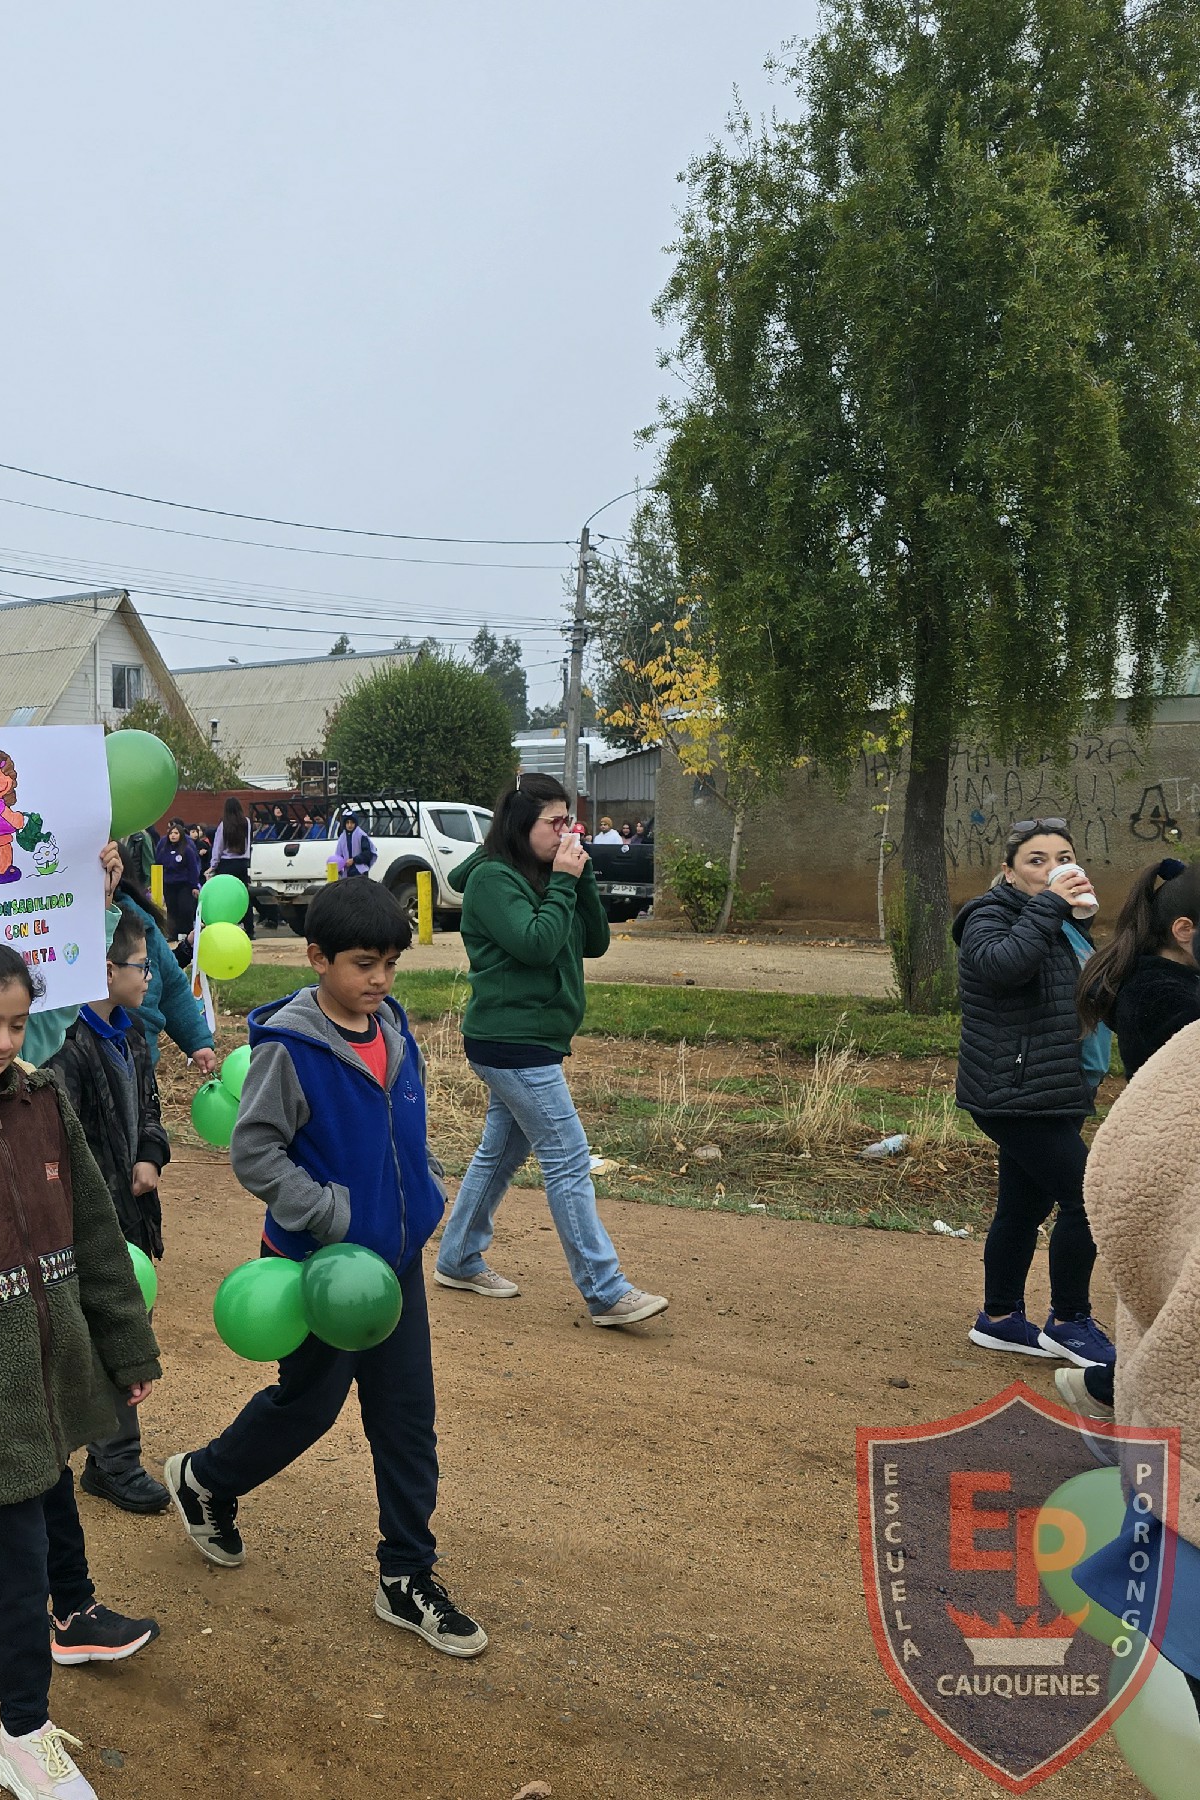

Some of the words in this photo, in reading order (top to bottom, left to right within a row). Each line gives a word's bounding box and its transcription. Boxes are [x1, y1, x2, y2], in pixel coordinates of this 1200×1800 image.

[4, 923, 29, 940] CON
[33, 919, 50, 936] EL
[22, 947, 57, 966] NETA
